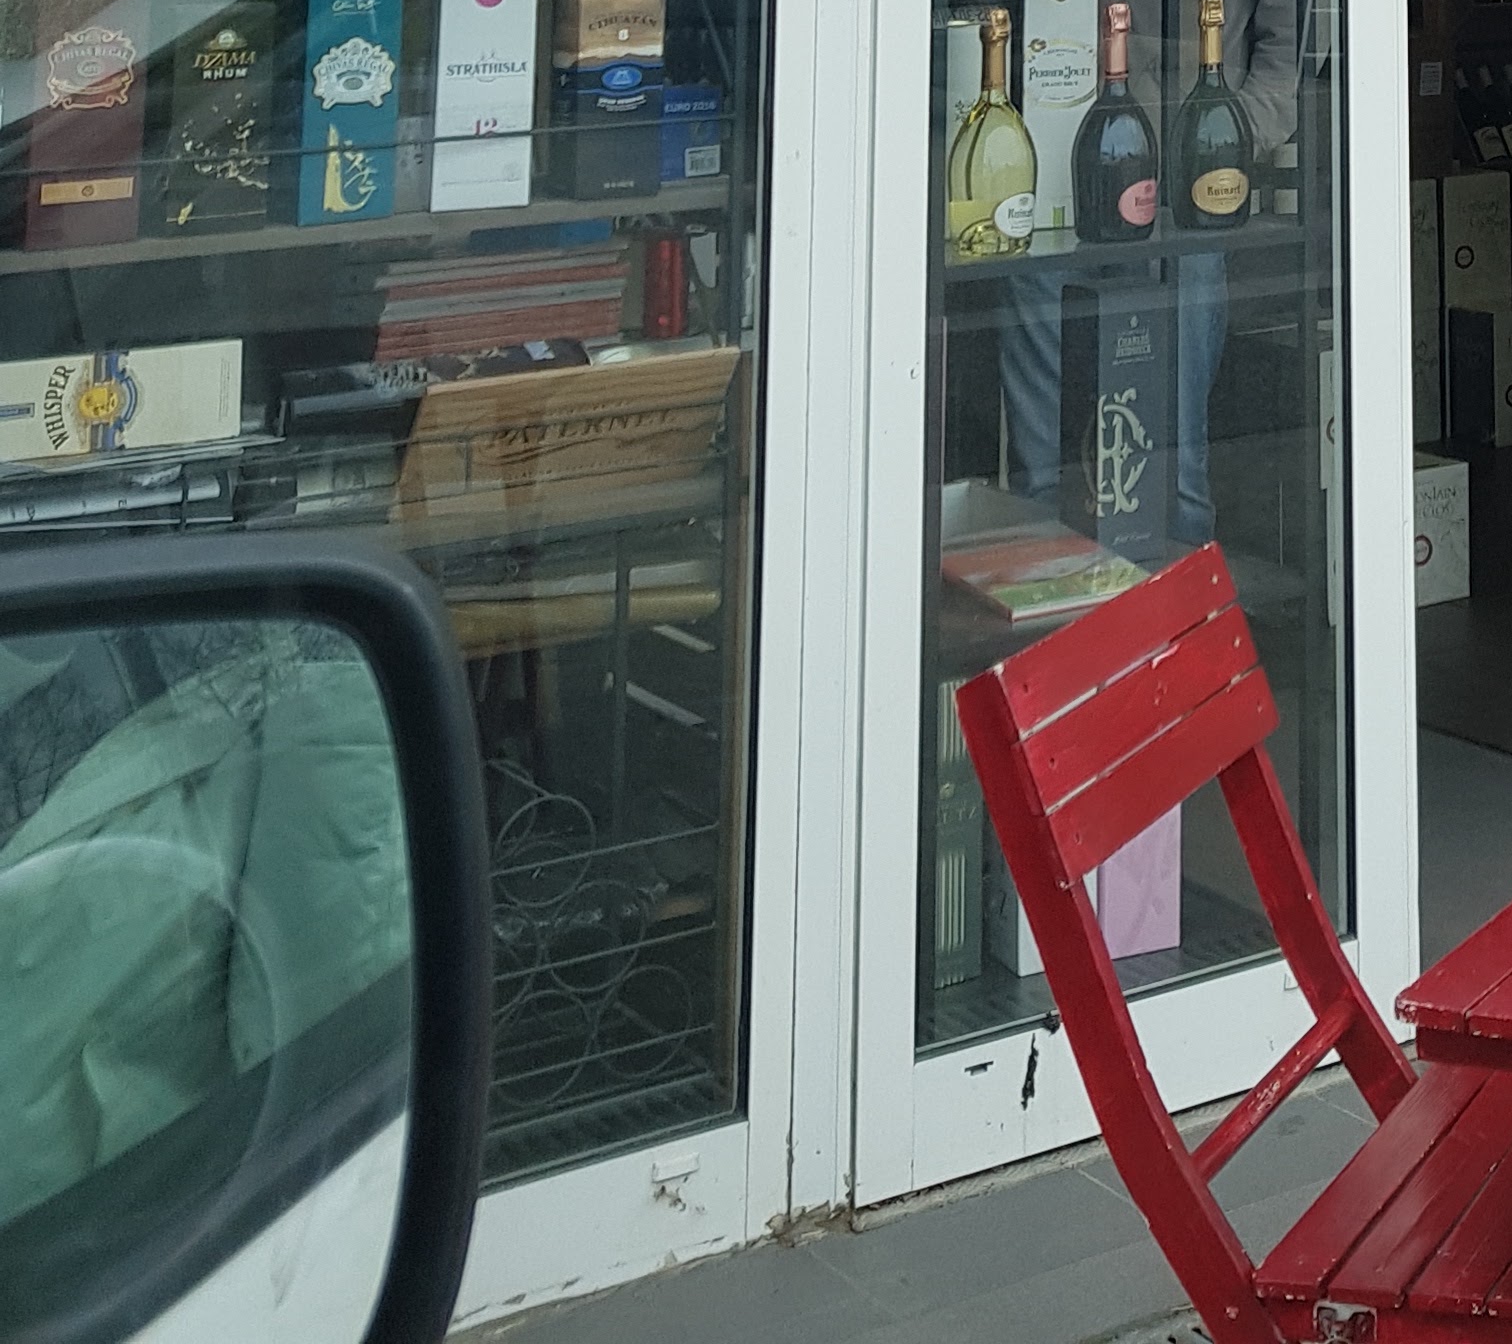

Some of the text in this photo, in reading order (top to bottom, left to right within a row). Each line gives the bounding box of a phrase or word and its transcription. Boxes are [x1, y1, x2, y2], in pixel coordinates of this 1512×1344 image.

[203, 67, 248, 80] RHUM
[446, 61, 528, 77] STRATHISLA
[44, 365, 76, 451] WHISPER
